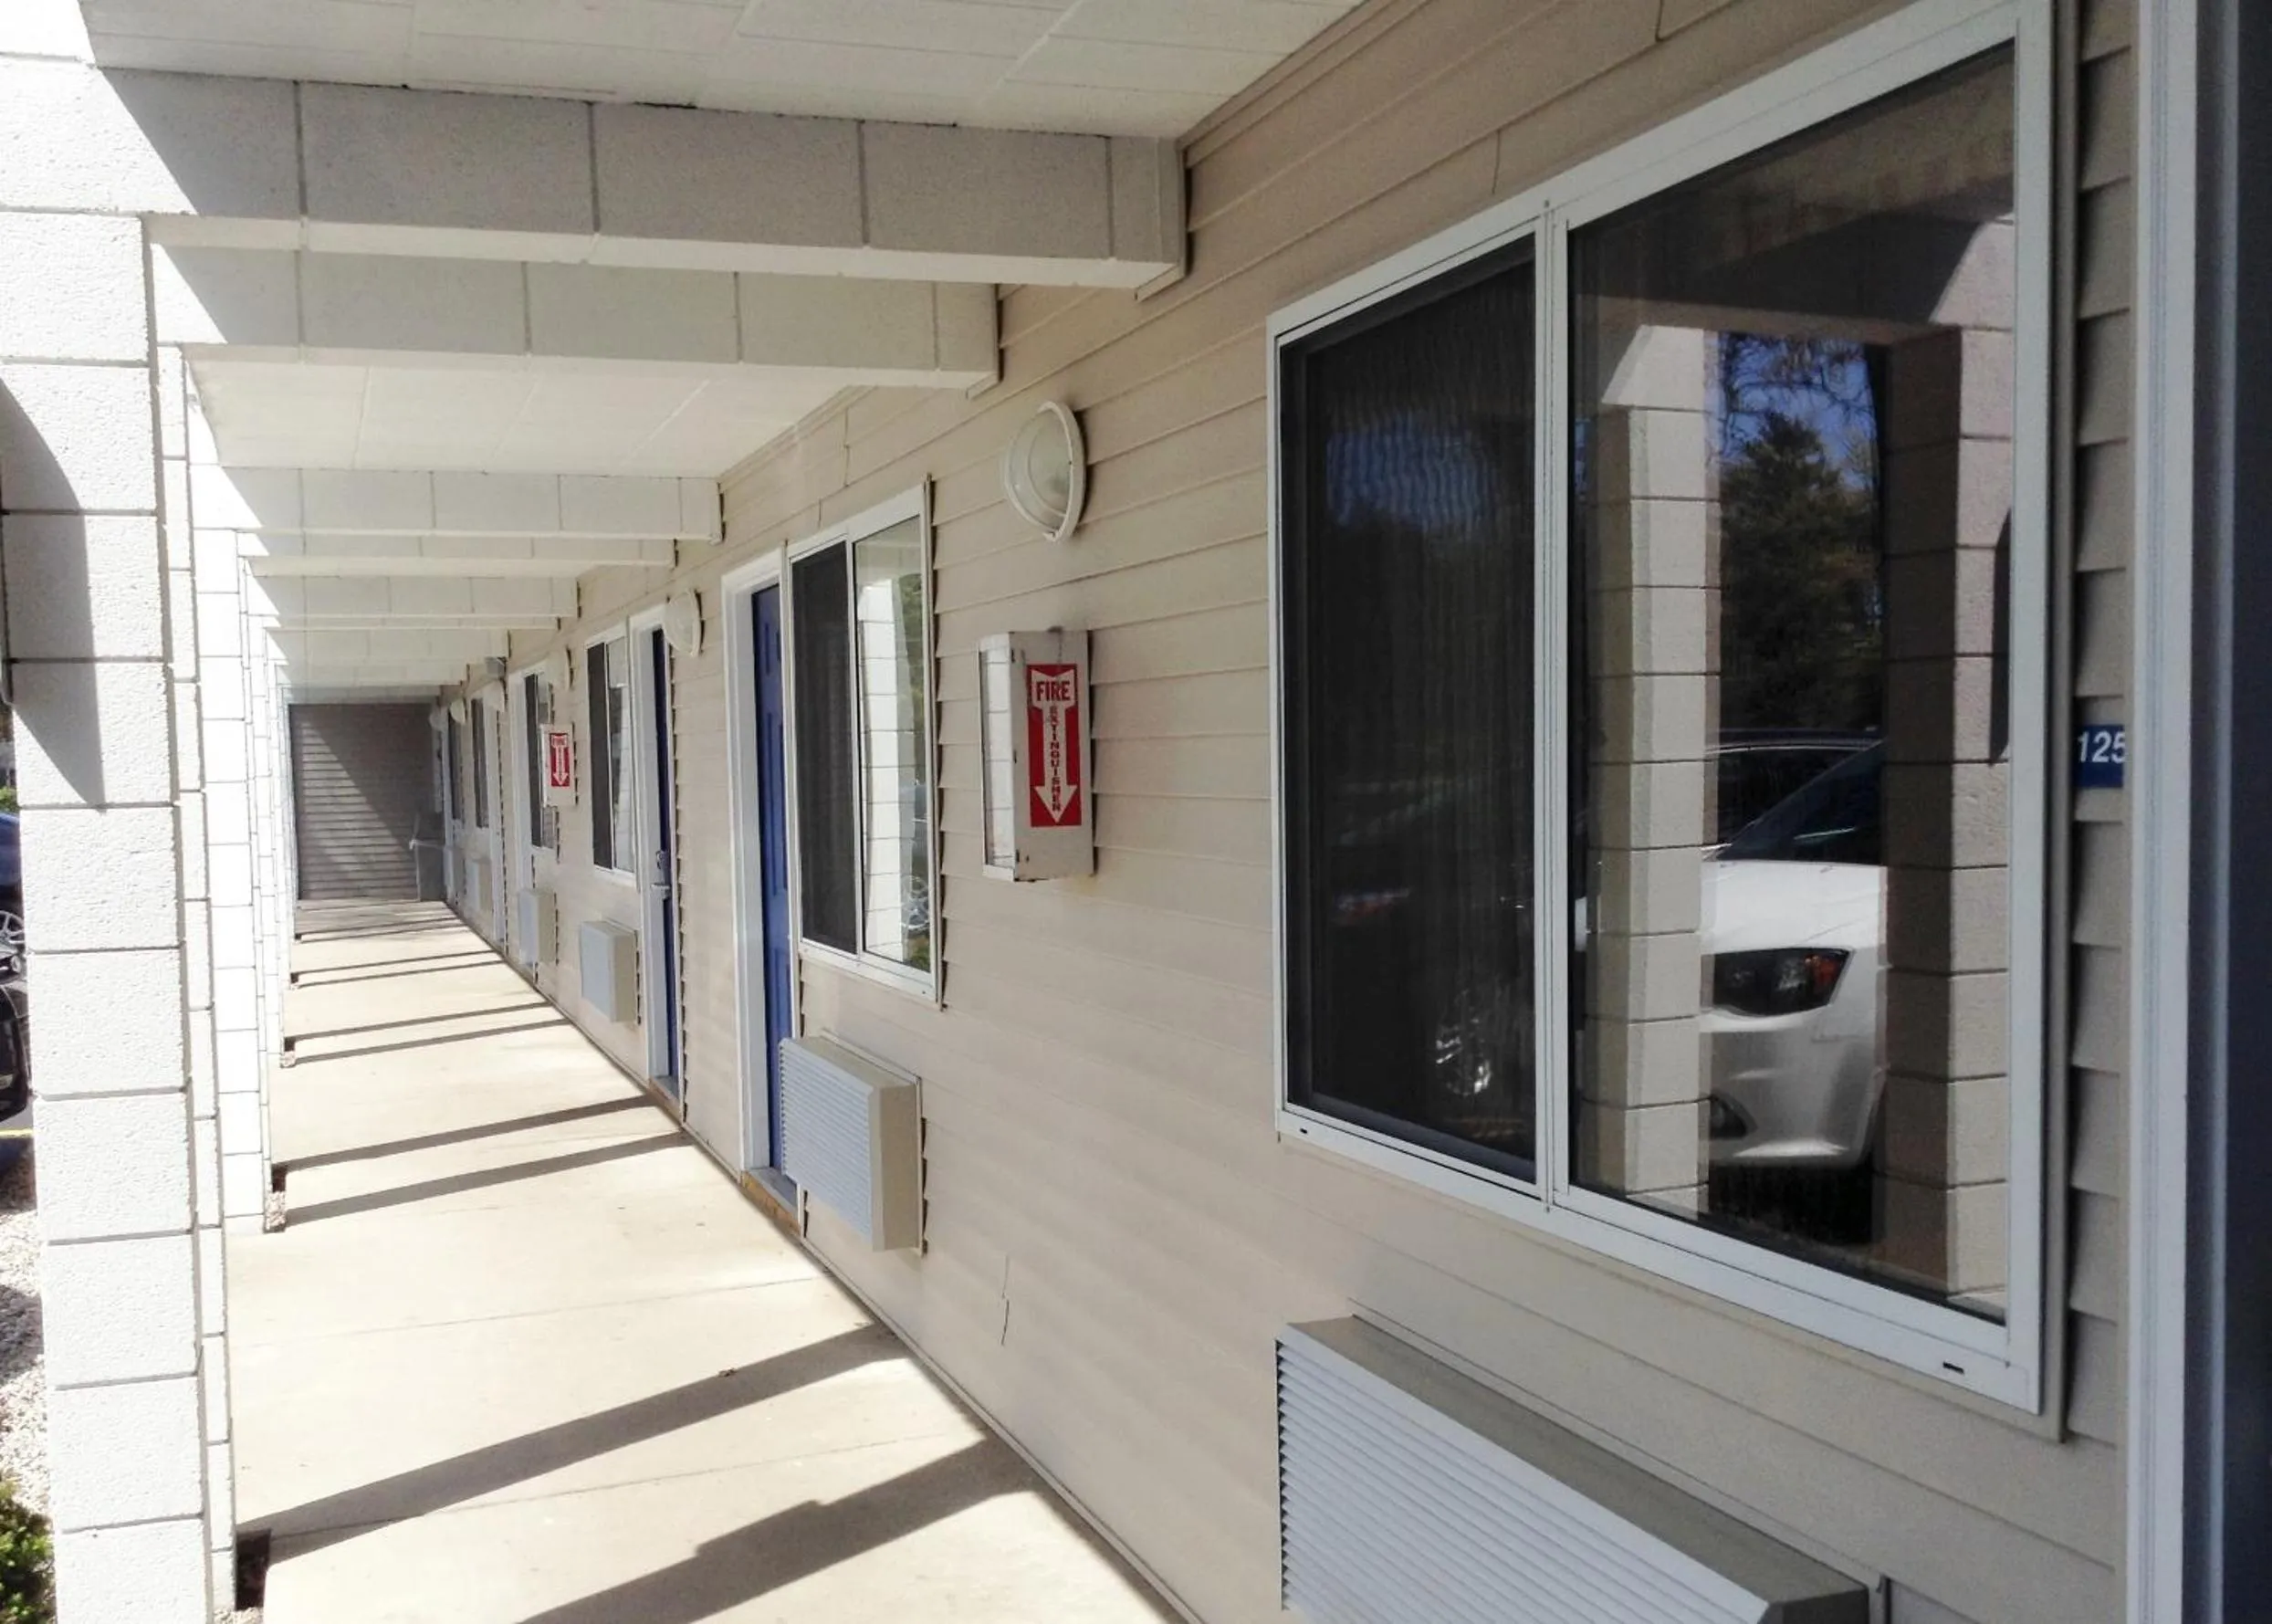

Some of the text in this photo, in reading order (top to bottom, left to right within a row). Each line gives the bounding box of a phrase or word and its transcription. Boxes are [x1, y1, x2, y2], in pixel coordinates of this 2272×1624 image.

[1036, 680, 1071, 702] FIRE
[1049, 705, 1062, 812] EXTINGUISHER
[2078, 729, 2126, 764] 125
